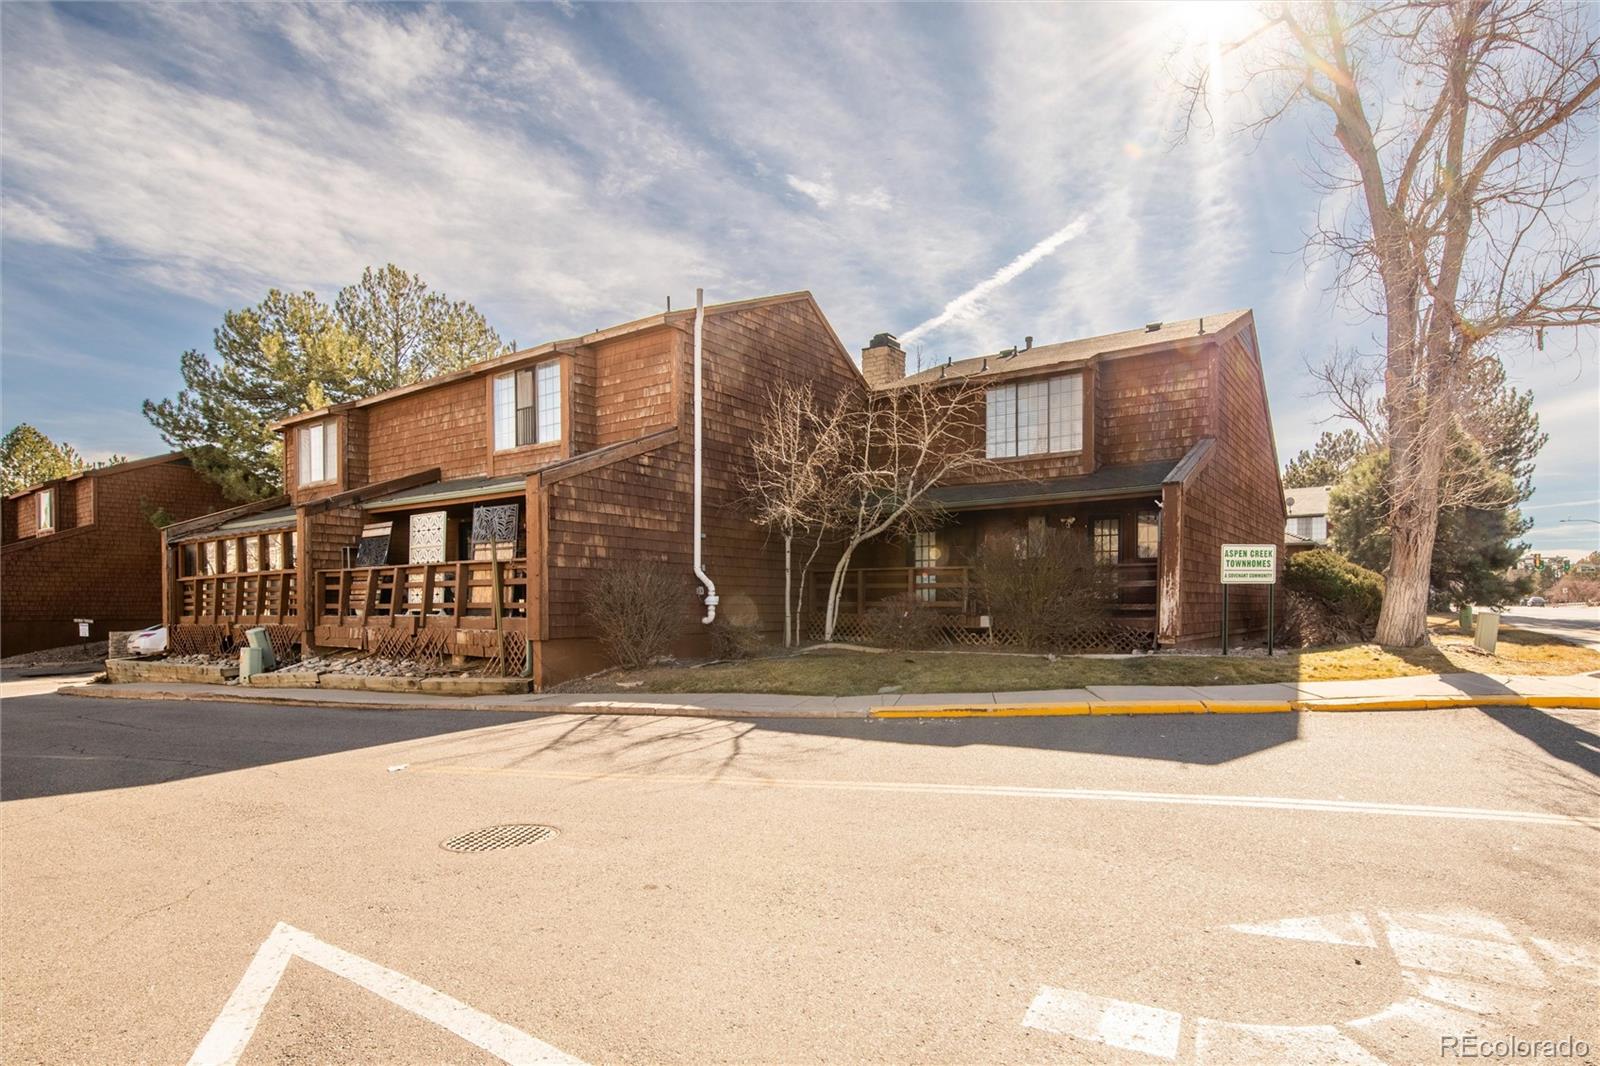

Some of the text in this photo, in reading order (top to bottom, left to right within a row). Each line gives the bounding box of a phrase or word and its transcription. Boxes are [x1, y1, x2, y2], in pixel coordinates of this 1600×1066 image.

[1224, 549, 1273, 558] ASPEN CREEK
[1226, 559, 1271, 568] TOWNHOMES
